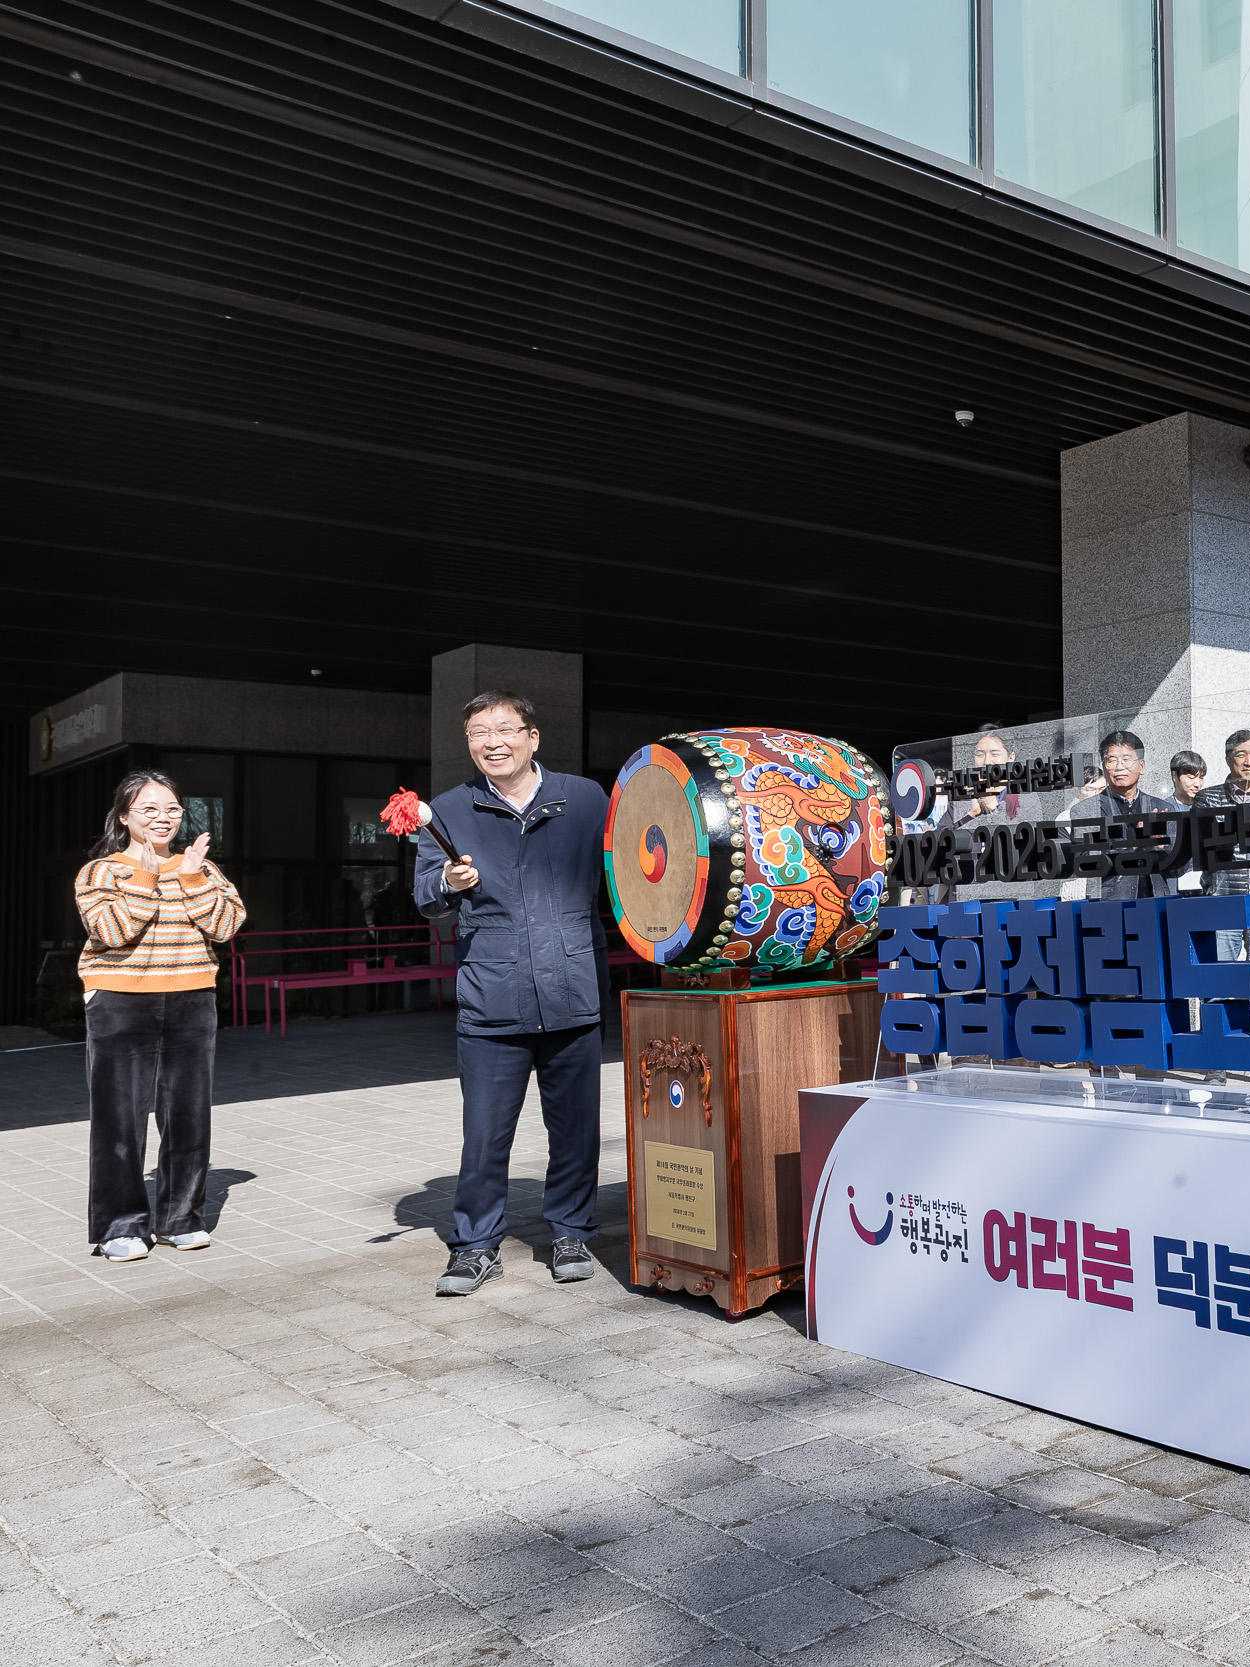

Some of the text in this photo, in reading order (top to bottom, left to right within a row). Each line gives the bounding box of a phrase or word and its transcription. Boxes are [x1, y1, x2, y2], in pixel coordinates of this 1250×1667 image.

[935, 752, 1086, 801] 국민권익위원회
[887, 821, 1066, 887] 2023-2025
[899, 1193, 968, 1225] 소통하며 발전하는
[899, 1216, 969, 1264] 행복광진
[982, 1208, 1134, 1312] 여러분
